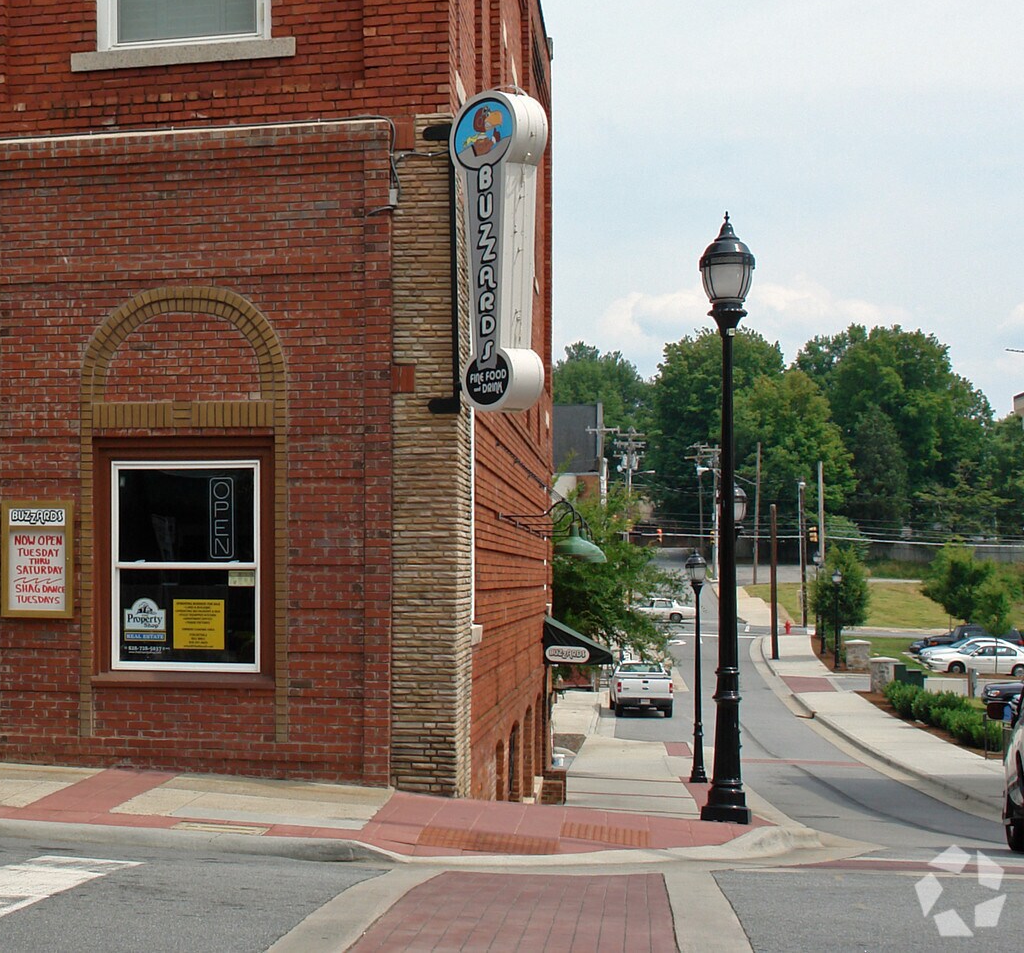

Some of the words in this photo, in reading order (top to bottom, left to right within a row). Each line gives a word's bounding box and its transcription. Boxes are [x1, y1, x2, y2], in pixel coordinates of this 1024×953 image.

[476, 163, 497, 363] BUZZARDS
[485, 368, 507, 381] FOOD
[482, 381, 504, 394] DRINK
[11, 509, 64, 525] BUZZARDS
[213, 482, 230, 555] OPEN
[14, 535, 36, 546] NOW
[38, 535, 63, 546] OPEN
[17, 548, 60, 557] TUESDAY
[29, 557, 50, 565] THRU
[16, 565, 63, 575] SATURDAY
[15, 584, 41, 593] SHAG
[42, 584, 65, 594] DANCE
[16, 595, 60, 605] TUESDAYS
[127, 613, 163, 624] Property
[549, 648, 586, 660] BUZZARDS
